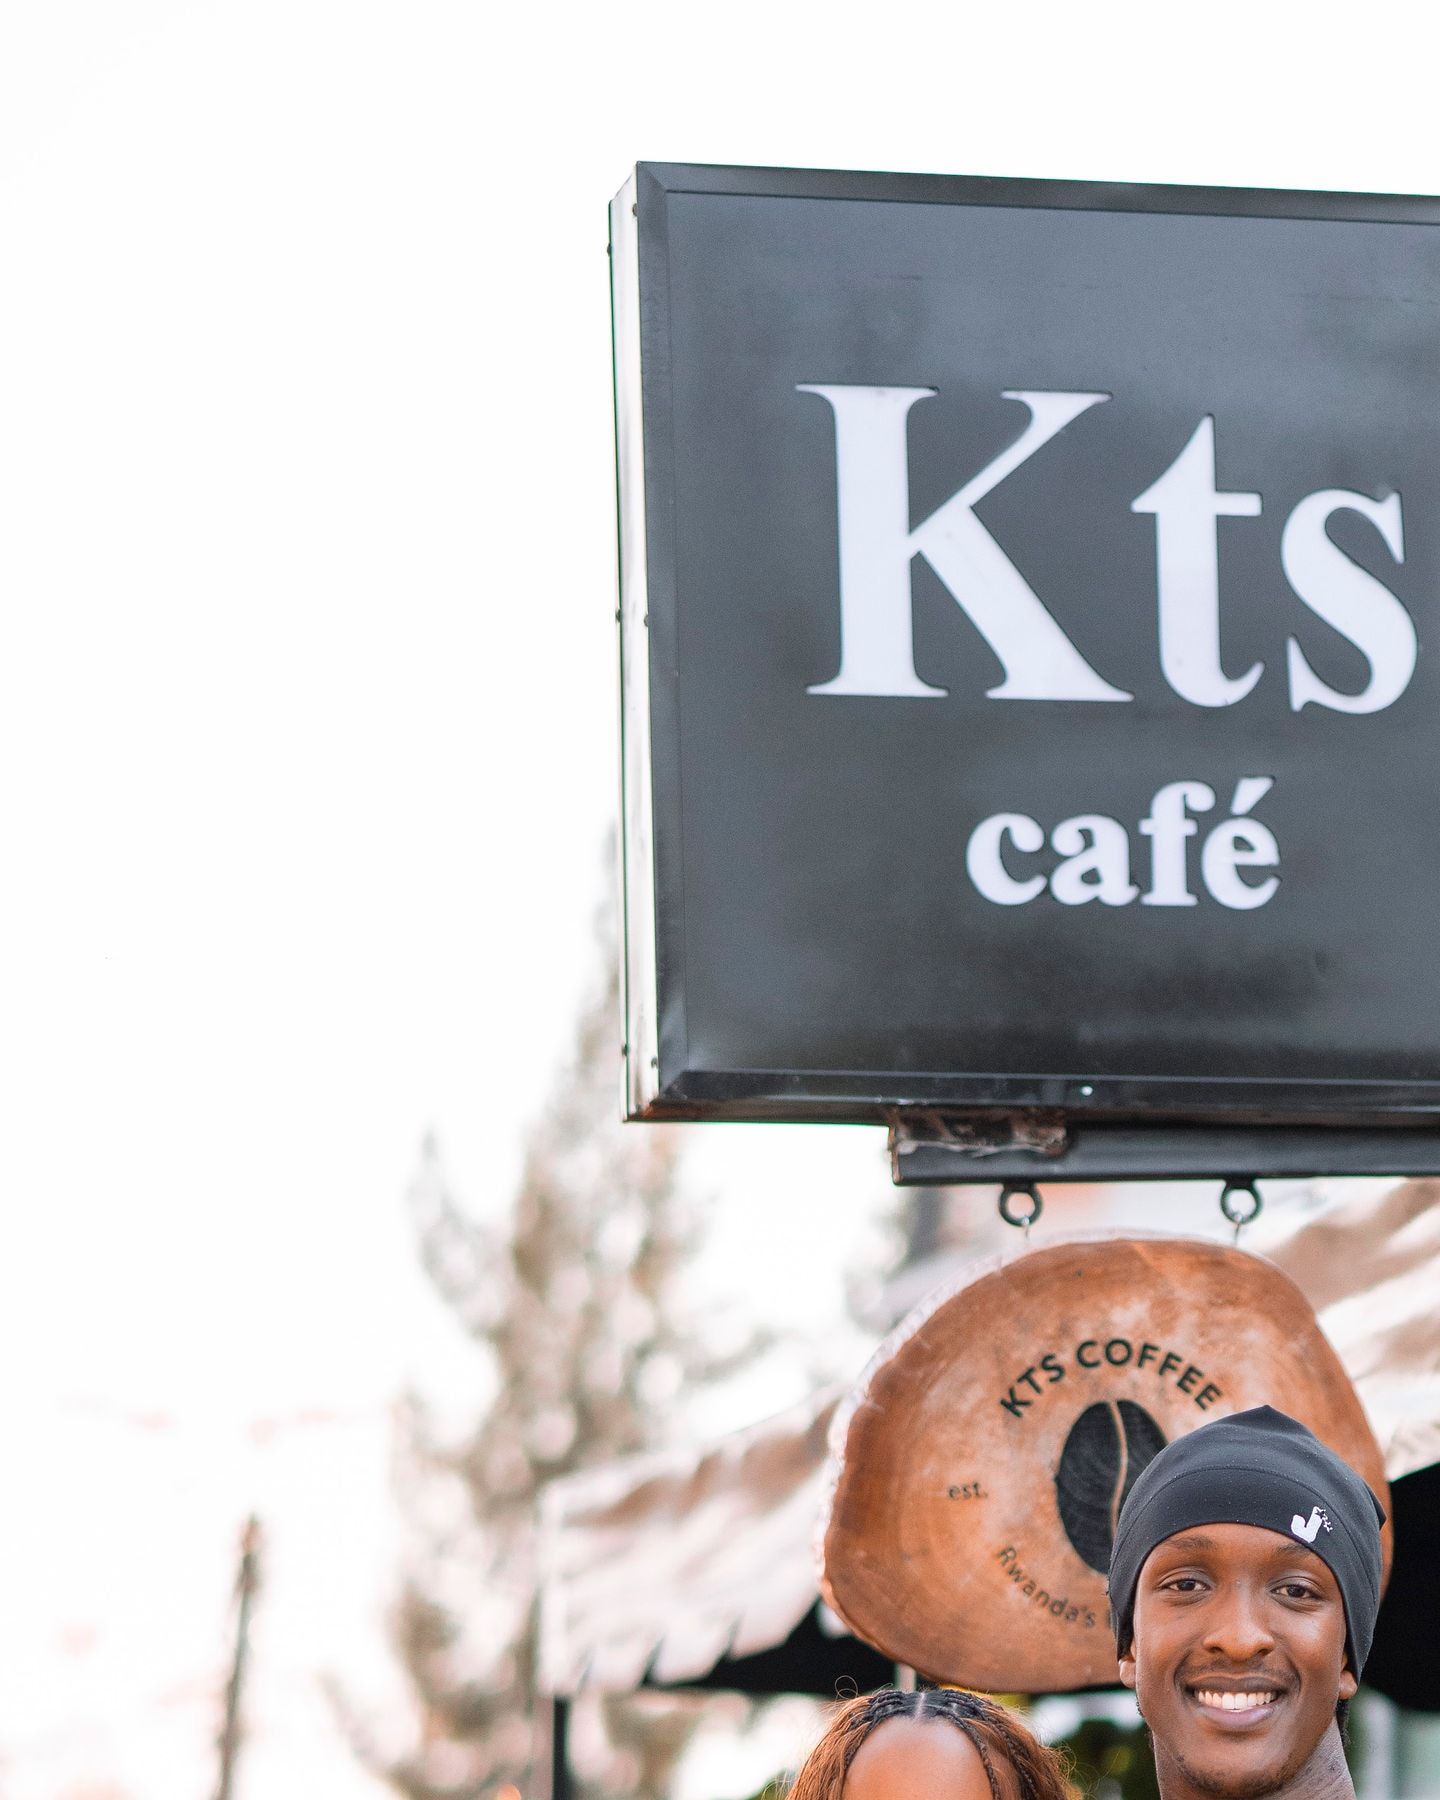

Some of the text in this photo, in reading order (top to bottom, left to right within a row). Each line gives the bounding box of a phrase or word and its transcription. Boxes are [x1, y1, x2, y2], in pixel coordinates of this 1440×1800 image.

[796, 384, 1419, 715] Kts
[966, 776, 1281, 910] café
[1000, 1339, 1224, 1419] KTS COFFEE
[949, 1481, 988, 1499] est.
[999, 1545, 1095, 1628] Rwanda's
